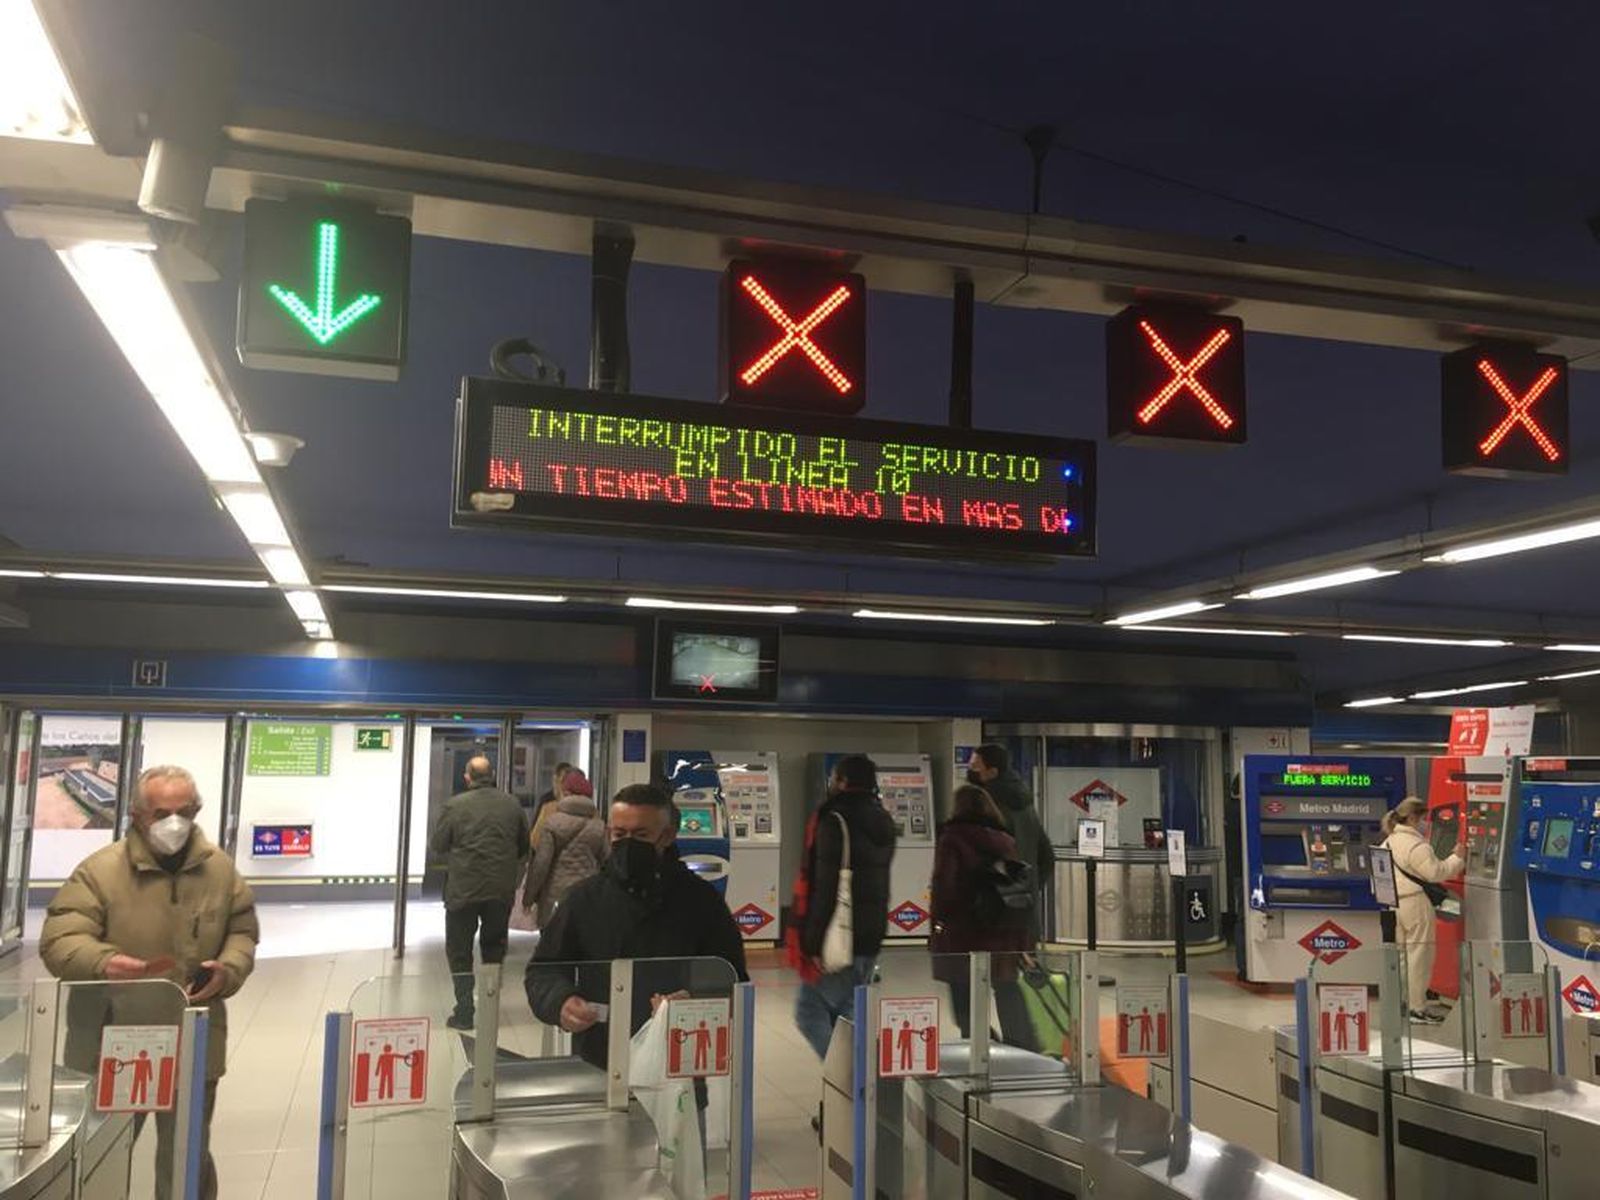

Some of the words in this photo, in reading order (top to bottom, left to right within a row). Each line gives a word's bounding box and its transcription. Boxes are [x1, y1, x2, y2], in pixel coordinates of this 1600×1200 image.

[528, 408, 796, 457] INTERRUMPIDO
[818, 436, 858, 467] EL
[881, 443, 1040, 483] SERVICIO
[676, 449, 719, 479] EN
[741, 453, 849, 491] LINEA
[875, 468, 911, 495] 10
[488, 459, 523, 491] N
[548, 464, 688, 504] TIEMPO
[710, 478, 882, 519] ESTIMADO
[902, 494, 945, 525] EN
[963, 499, 1023, 531] MAS
[1284, 773, 1316, 785] FUERA
[1320, 774, 1371, 786] SERVICIO
[1299, 802, 1330, 813] Metro
[1332, 803, 1370, 814] Madrid
[738, 914, 762, 924] Metro
[1313, 936, 1346, 949] Metro
